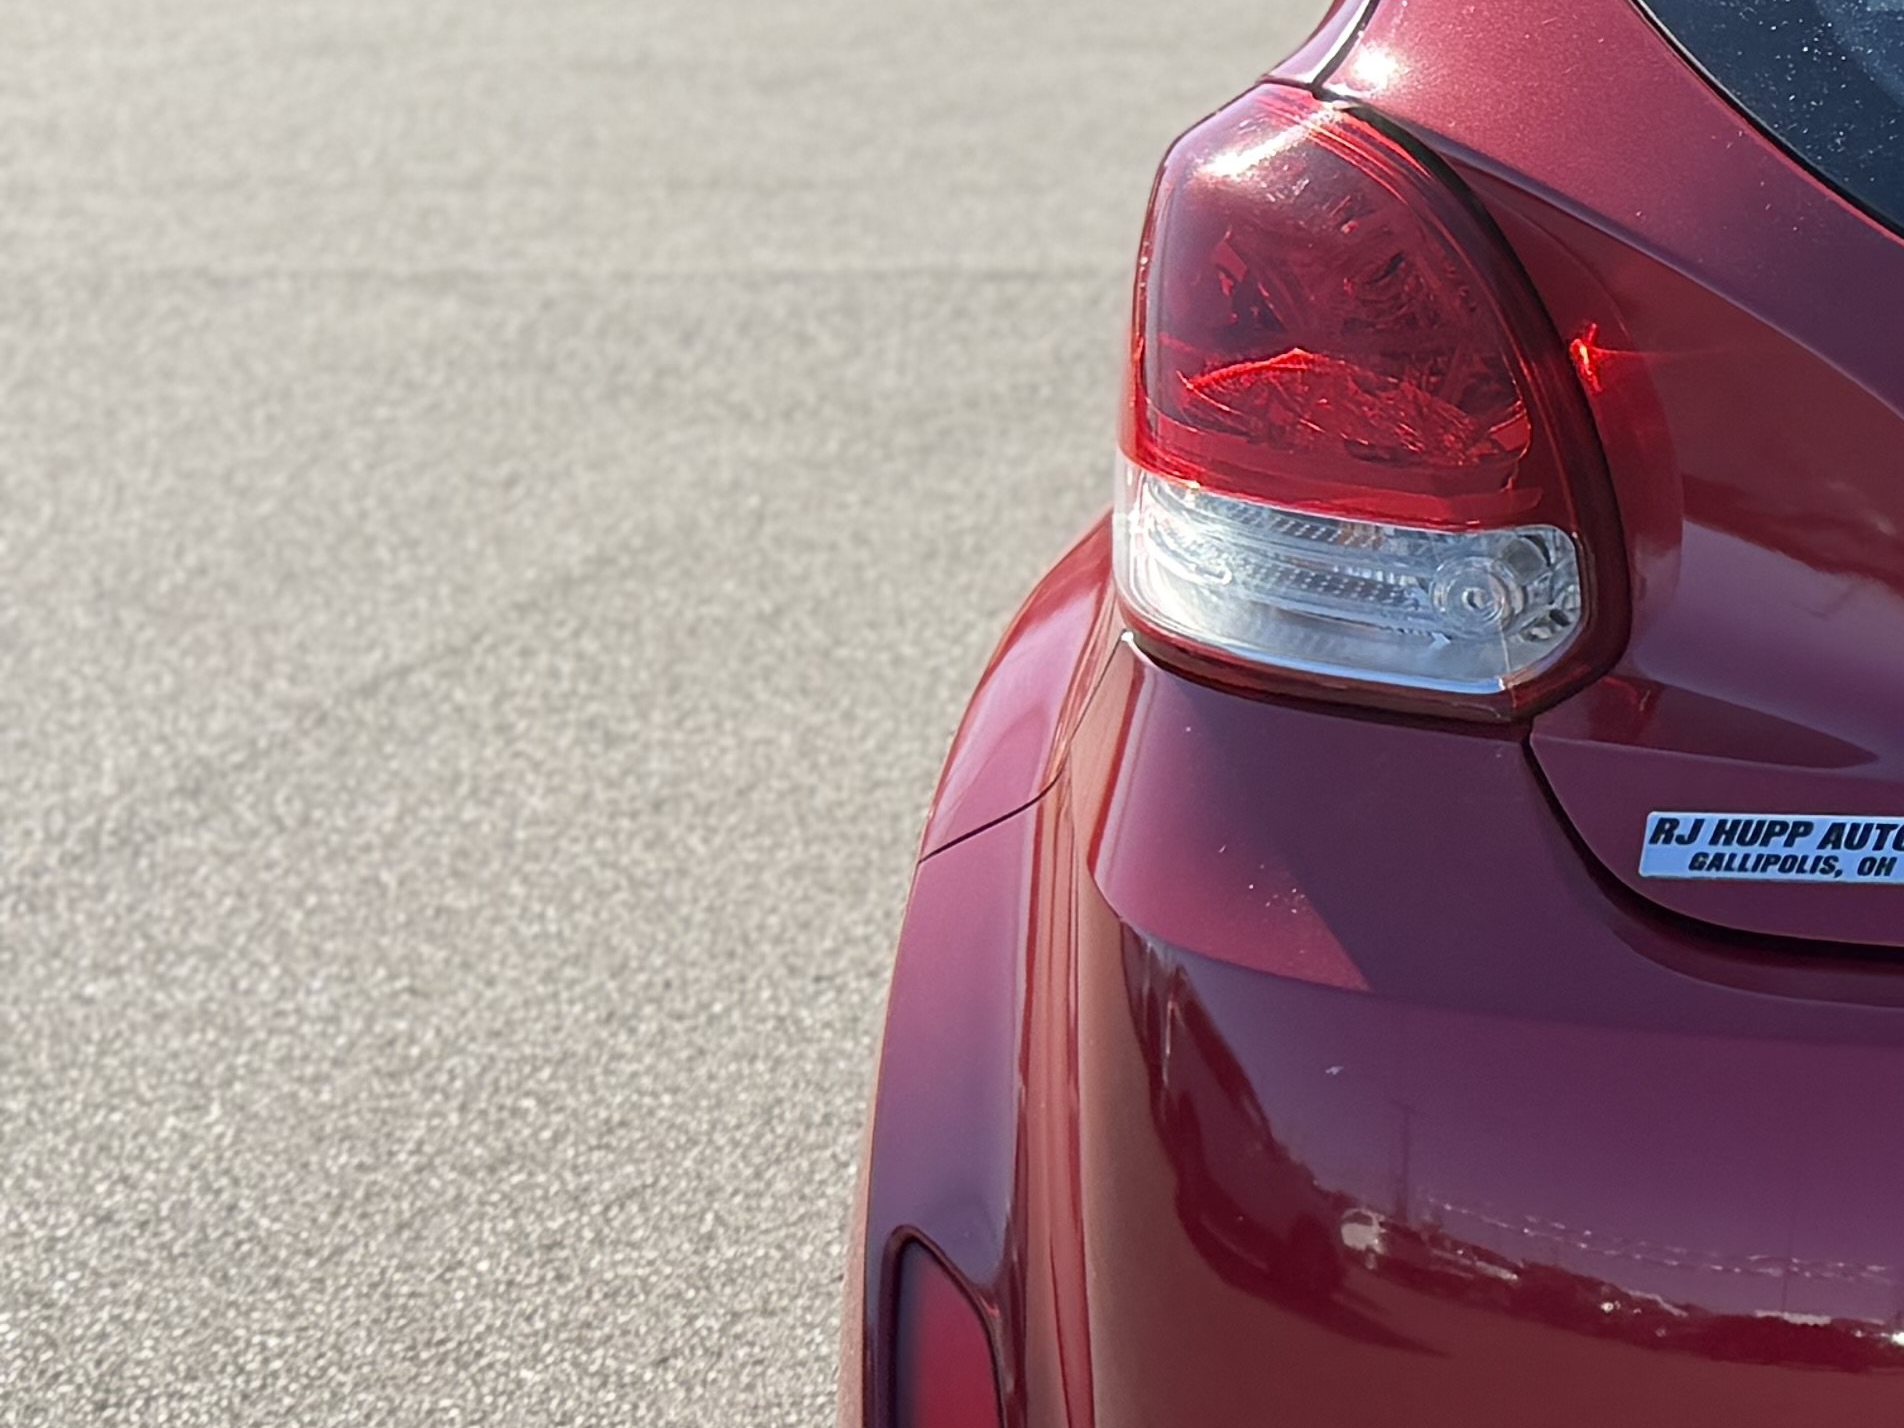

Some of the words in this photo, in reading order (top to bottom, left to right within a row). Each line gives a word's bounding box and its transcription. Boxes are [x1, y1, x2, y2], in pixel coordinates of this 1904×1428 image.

[1650, 817, 1705, 845] RJ
[1708, 818, 1814, 848] HUPP
[1688, 852, 1843, 878] GALLIPOLIS,
[1857, 856, 1897, 877] OH
